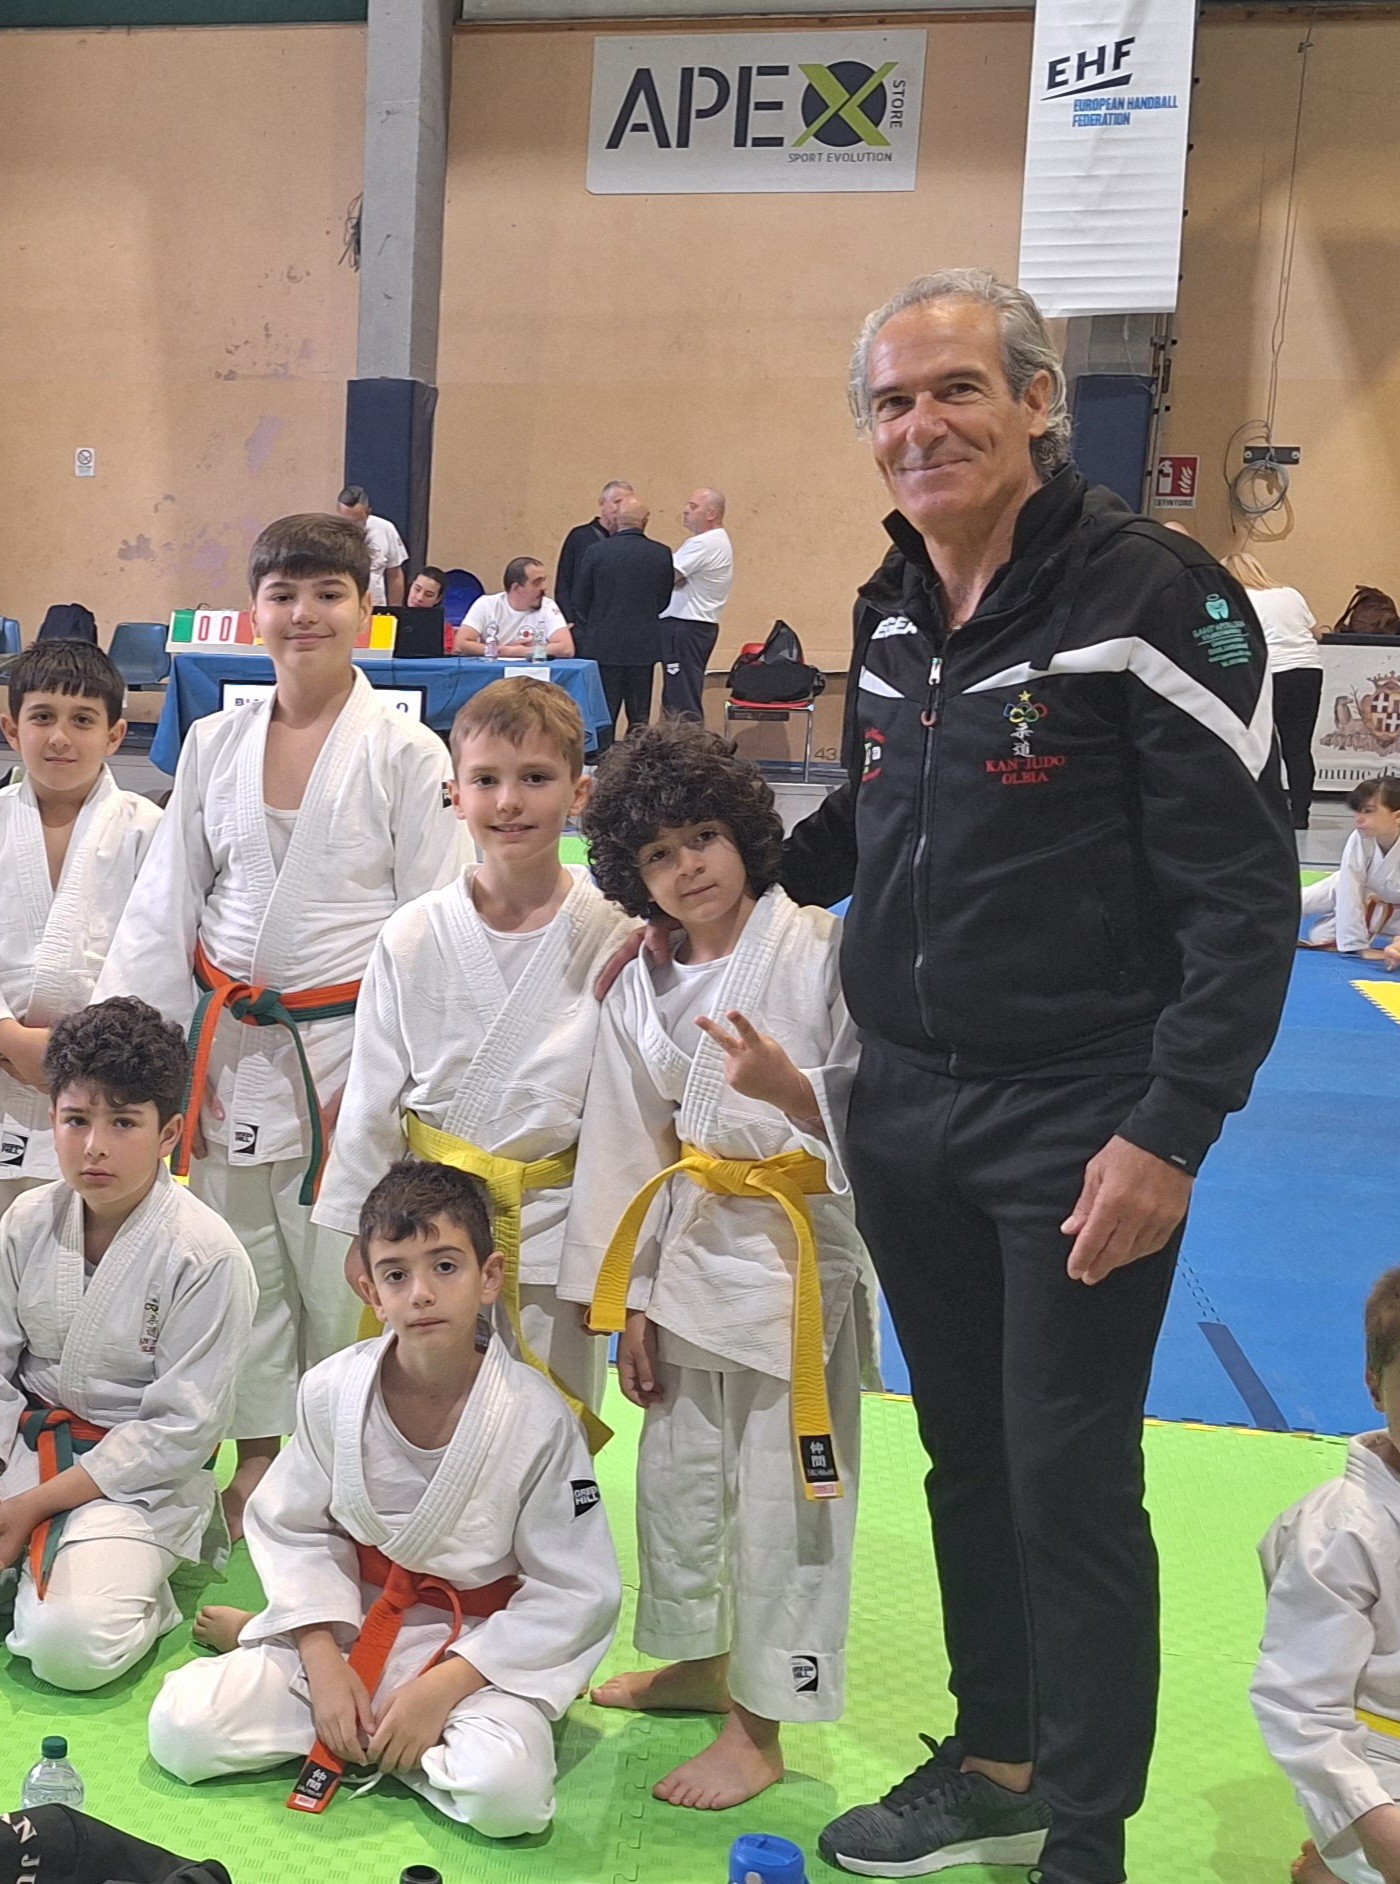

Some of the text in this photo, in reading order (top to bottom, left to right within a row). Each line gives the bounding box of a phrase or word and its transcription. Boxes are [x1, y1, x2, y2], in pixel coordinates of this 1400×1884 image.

[1046, 36, 1136, 91] EHF
[605, 61, 899, 149] APEX
[889, 80, 906, 129] STORE
[1073, 95, 1178, 112] EUROPEAN HANDBALL
[1072, 112, 1131, 127] FEDERATION
[788, 152, 893, 163] SPORT EVOLUTION
[814, 748, 837, 760] 43
[985, 755, 1066, 773] KAN JUDO
[1001, 771, 1050, 785] OLBIA
[1318, 768, 1371, 781] mune
